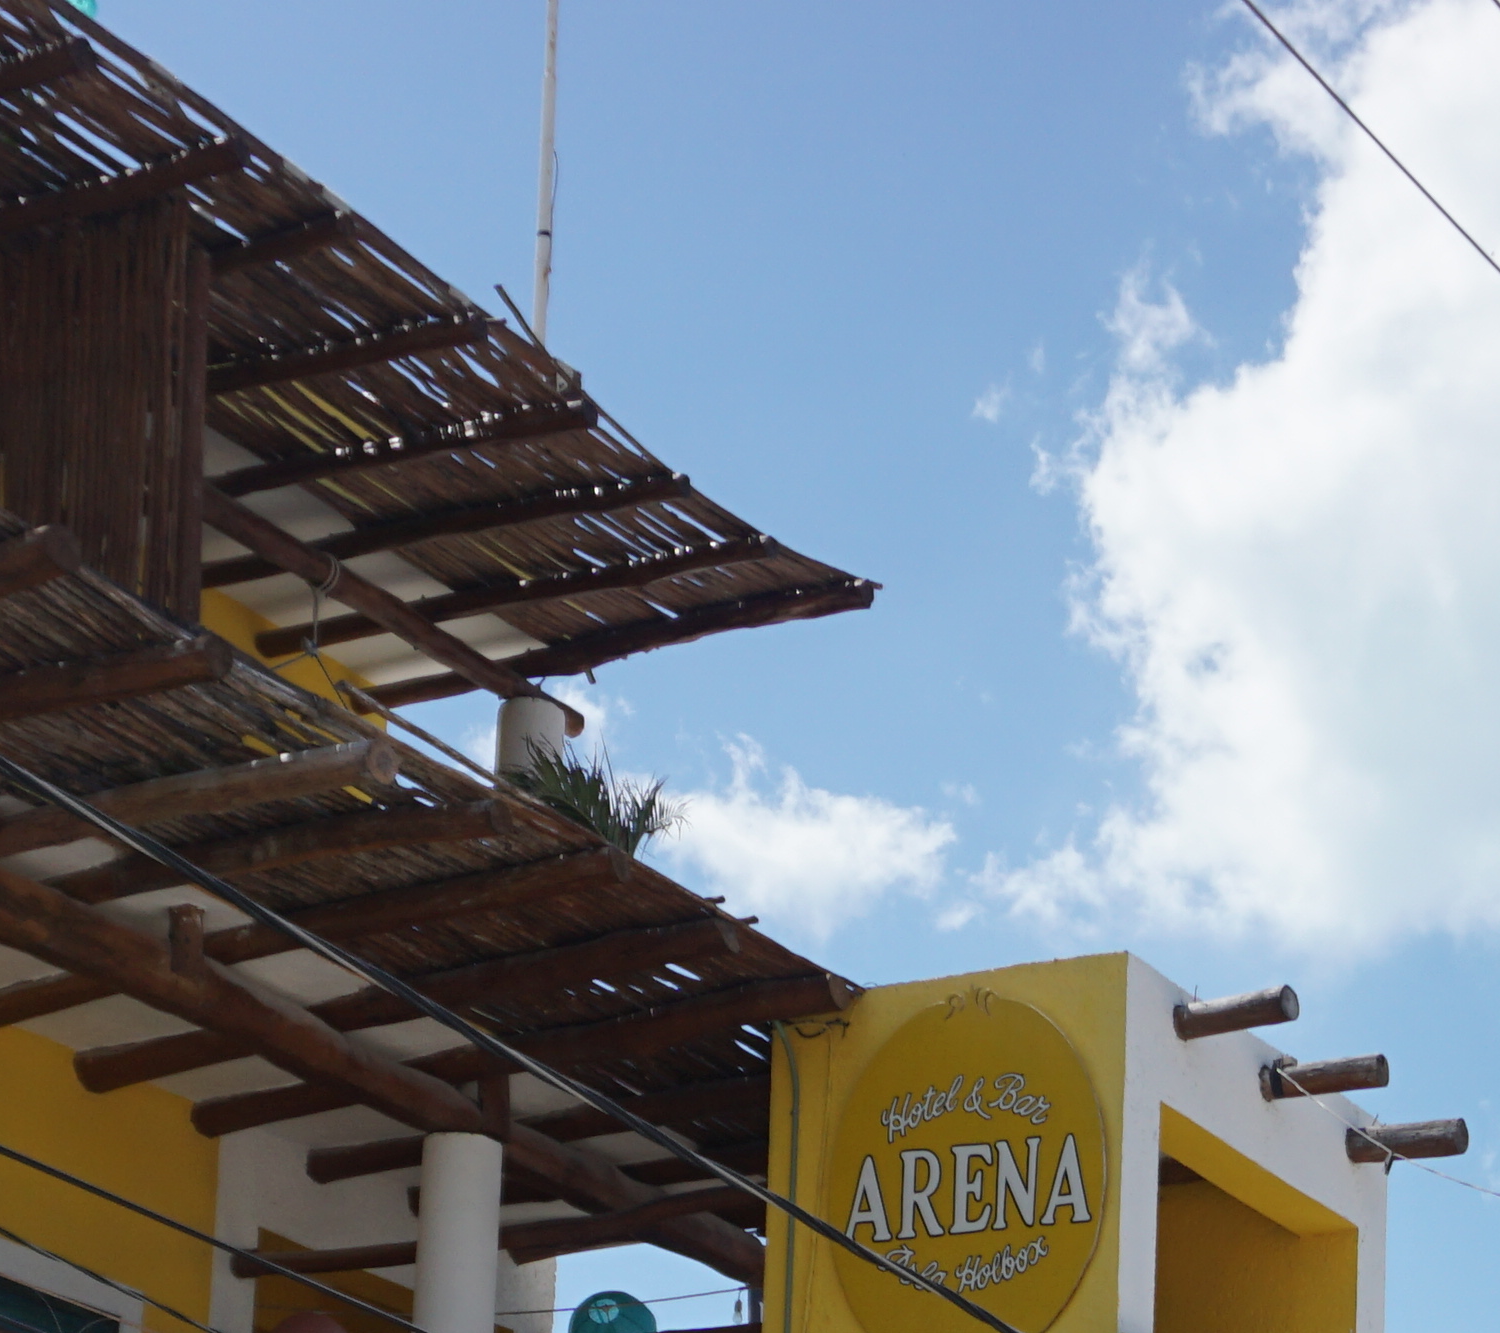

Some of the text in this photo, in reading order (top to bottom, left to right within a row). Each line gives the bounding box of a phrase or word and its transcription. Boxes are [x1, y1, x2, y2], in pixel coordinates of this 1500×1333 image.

[881, 1072, 1051, 1143] Hotel & Bar
[845, 1133, 1092, 1242] ARENA
[955, 1235, 1049, 1294] Holbox
